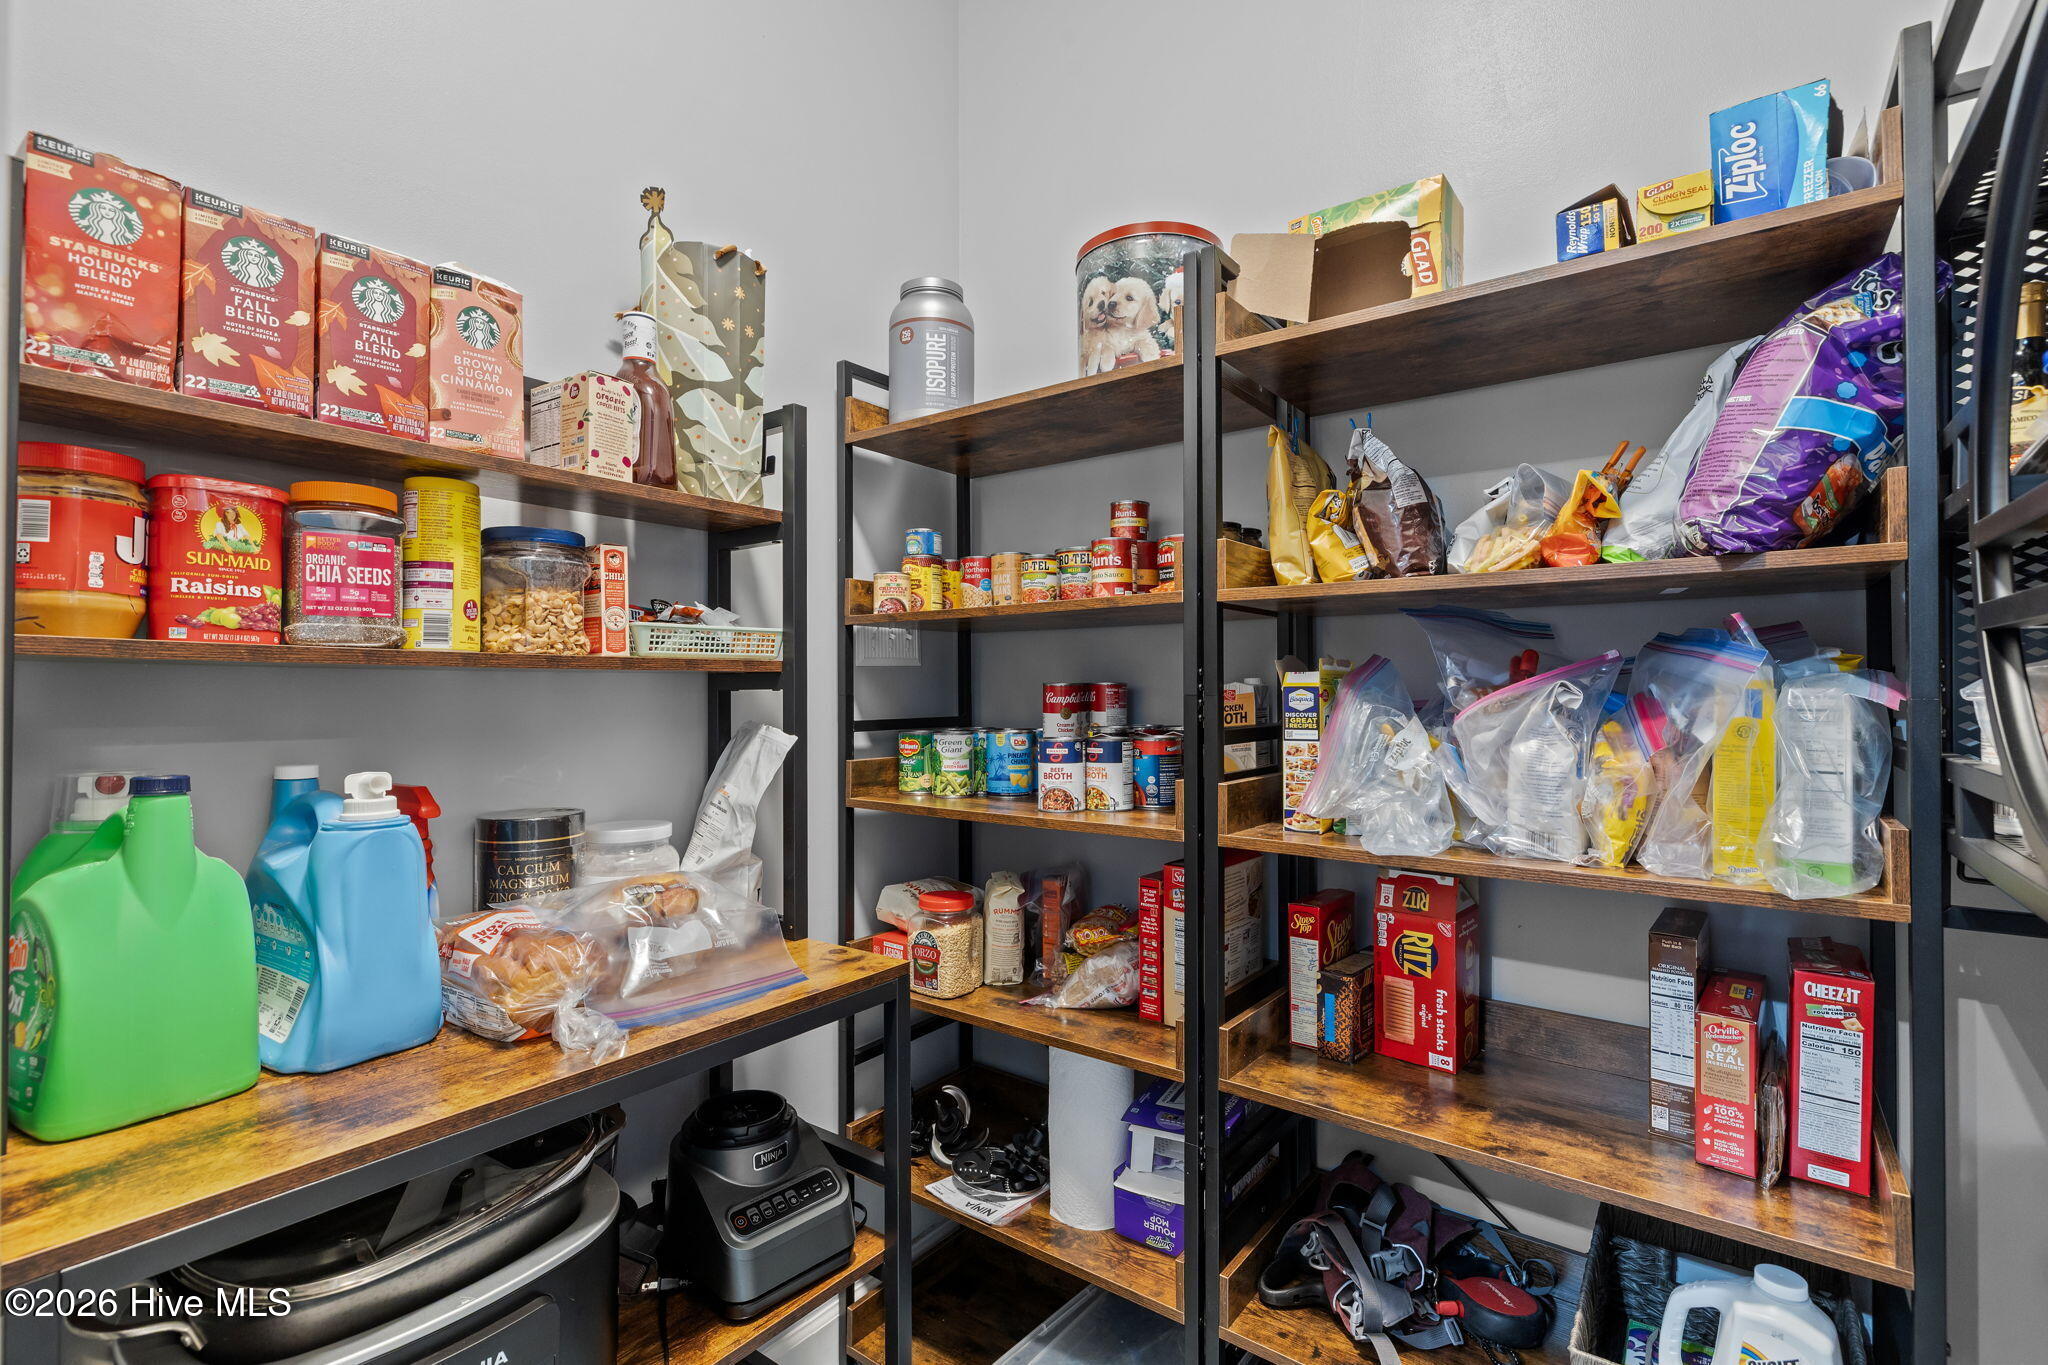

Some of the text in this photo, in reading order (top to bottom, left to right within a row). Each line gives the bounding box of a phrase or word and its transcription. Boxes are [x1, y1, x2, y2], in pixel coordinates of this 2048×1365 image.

[1814, 84, 1827, 97] 66
[36, 136, 92, 161] KEURIG
[1724, 121, 1767, 200] Ziploc
[1646, 182, 1672, 197] GLAD
[1686, 185, 1709, 195] SEAL
[195, 193, 240, 212] KEURIG
[1580, 205, 1591, 226] 130
[1639, 223, 1663, 237] 200
[1670, 220, 1680, 228] 2X
[1566, 211, 1578, 254] Reynolds
[1577, 225, 1591, 254] Wrap
[49, 236, 160, 273] STARBUCKS
[329, 238, 367, 255] KEURIG
[68, 252, 142, 280] HOLIDAY
[1411, 236, 1433, 284] GLAD
[78, 266, 132, 288] BLEND
[436, 273, 471, 286] KEURIG
[74, 283, 99, 292] NOTES
[112, 291, 136, 302] SWEET
[230, 286, 279, 303] STARBUCKS
[110, 296, 134, 307] HERBS
[234, 295, 272, 315] FALL
[225, 305, 280, 327] BLEND
[223, 325, 281, 343] TOASTED CHESTNUT
[225, 320, 246, 330] NOTES
[255, 327, 273, 336] SPICE
[359, 322, 400, 337] STARBUCKS
[362, 330, 394, 348] FALL
[25, 339, 51, 357] 22
[354, 340, 401, 359] BLEND
[353, 358, 402, 373] TOASTED CHESTNUT
[355, 353, 373, 362] NOTES
[380, 359, 396, 367] SPICE
[453, 354, 503, 375] BROWN
[926, 332, 946, 392] ISOPURE
[184, 373, 207, 390] 22
[457, 365, 500, 384] SUGAR
[440, 373, 513, 398] CINNAMON
[319, 402, 340, 417] 22
[429, 425, 445, 439] 22
[305, 553, 347, 566] ORGANIC
[305, 564, 392, 586] CHIA SEEDS
[603, 572, 625, 581] CHILI
[170, 577, 262, 599] Raisins
[938, 738, 963, 747] Green
[940, 746, 964, 754] Giant
[1013, 739, 1027, 747] Dole
[1043, 772, 1073, 780] BROTH
[497, 861, 560, 876] CALCIUM
[489, 872, 570, 889] MAGNESIUM
[488, 891, 531, 903] ZINC &
[1402, 891, 1430, 912] RITZ
[1290, 913, 1316, 930] Stove
[1299, 923, 1312, 934] Top
[914, 947, 937, 960] ORZO
[1402, 930, 1434, 980] RITZ
[1657, 962, 1687, 972] ORIGINAL
[1651, 974, 1693, 987] Nutrition Facts
[1651, 999, 1668, 1007] Calories
[1435, 989, 1448, 1052] fresh stacks
[1708, 1024, 1740, 1036] Orville
[1801, 1022, 1861, 1038] Nutrition Facts
[1712, 1042, 1740, 1056] Only
[1801, 1040, 1861, 1057] Calories 150
[1440, 1057, 1450, 1066] 8
[1705, 1049, 1745, 1067] REAL
[1705, 1059, 1745, 1072] INGREDIENTS
[1714, 1107, 1745, 1120] 100%
[1713, 1118, 1745, 1129] POPCORN
[1729, 1131, 1745, 1140] FREE
[1713, 1142, 1745, 1153] NON-GMO
[1713, 1145, 1745, 1158] POPCORN
[760, 1148, 783, 1165] NINJA
[965, 1201, 998, 1217] NINJA
[1143, 1219, 1176, 1239] POWER
[1150, 1215, 1169, 1228] MOP
[1145, 1234, 1175, 1252] Swiffer
